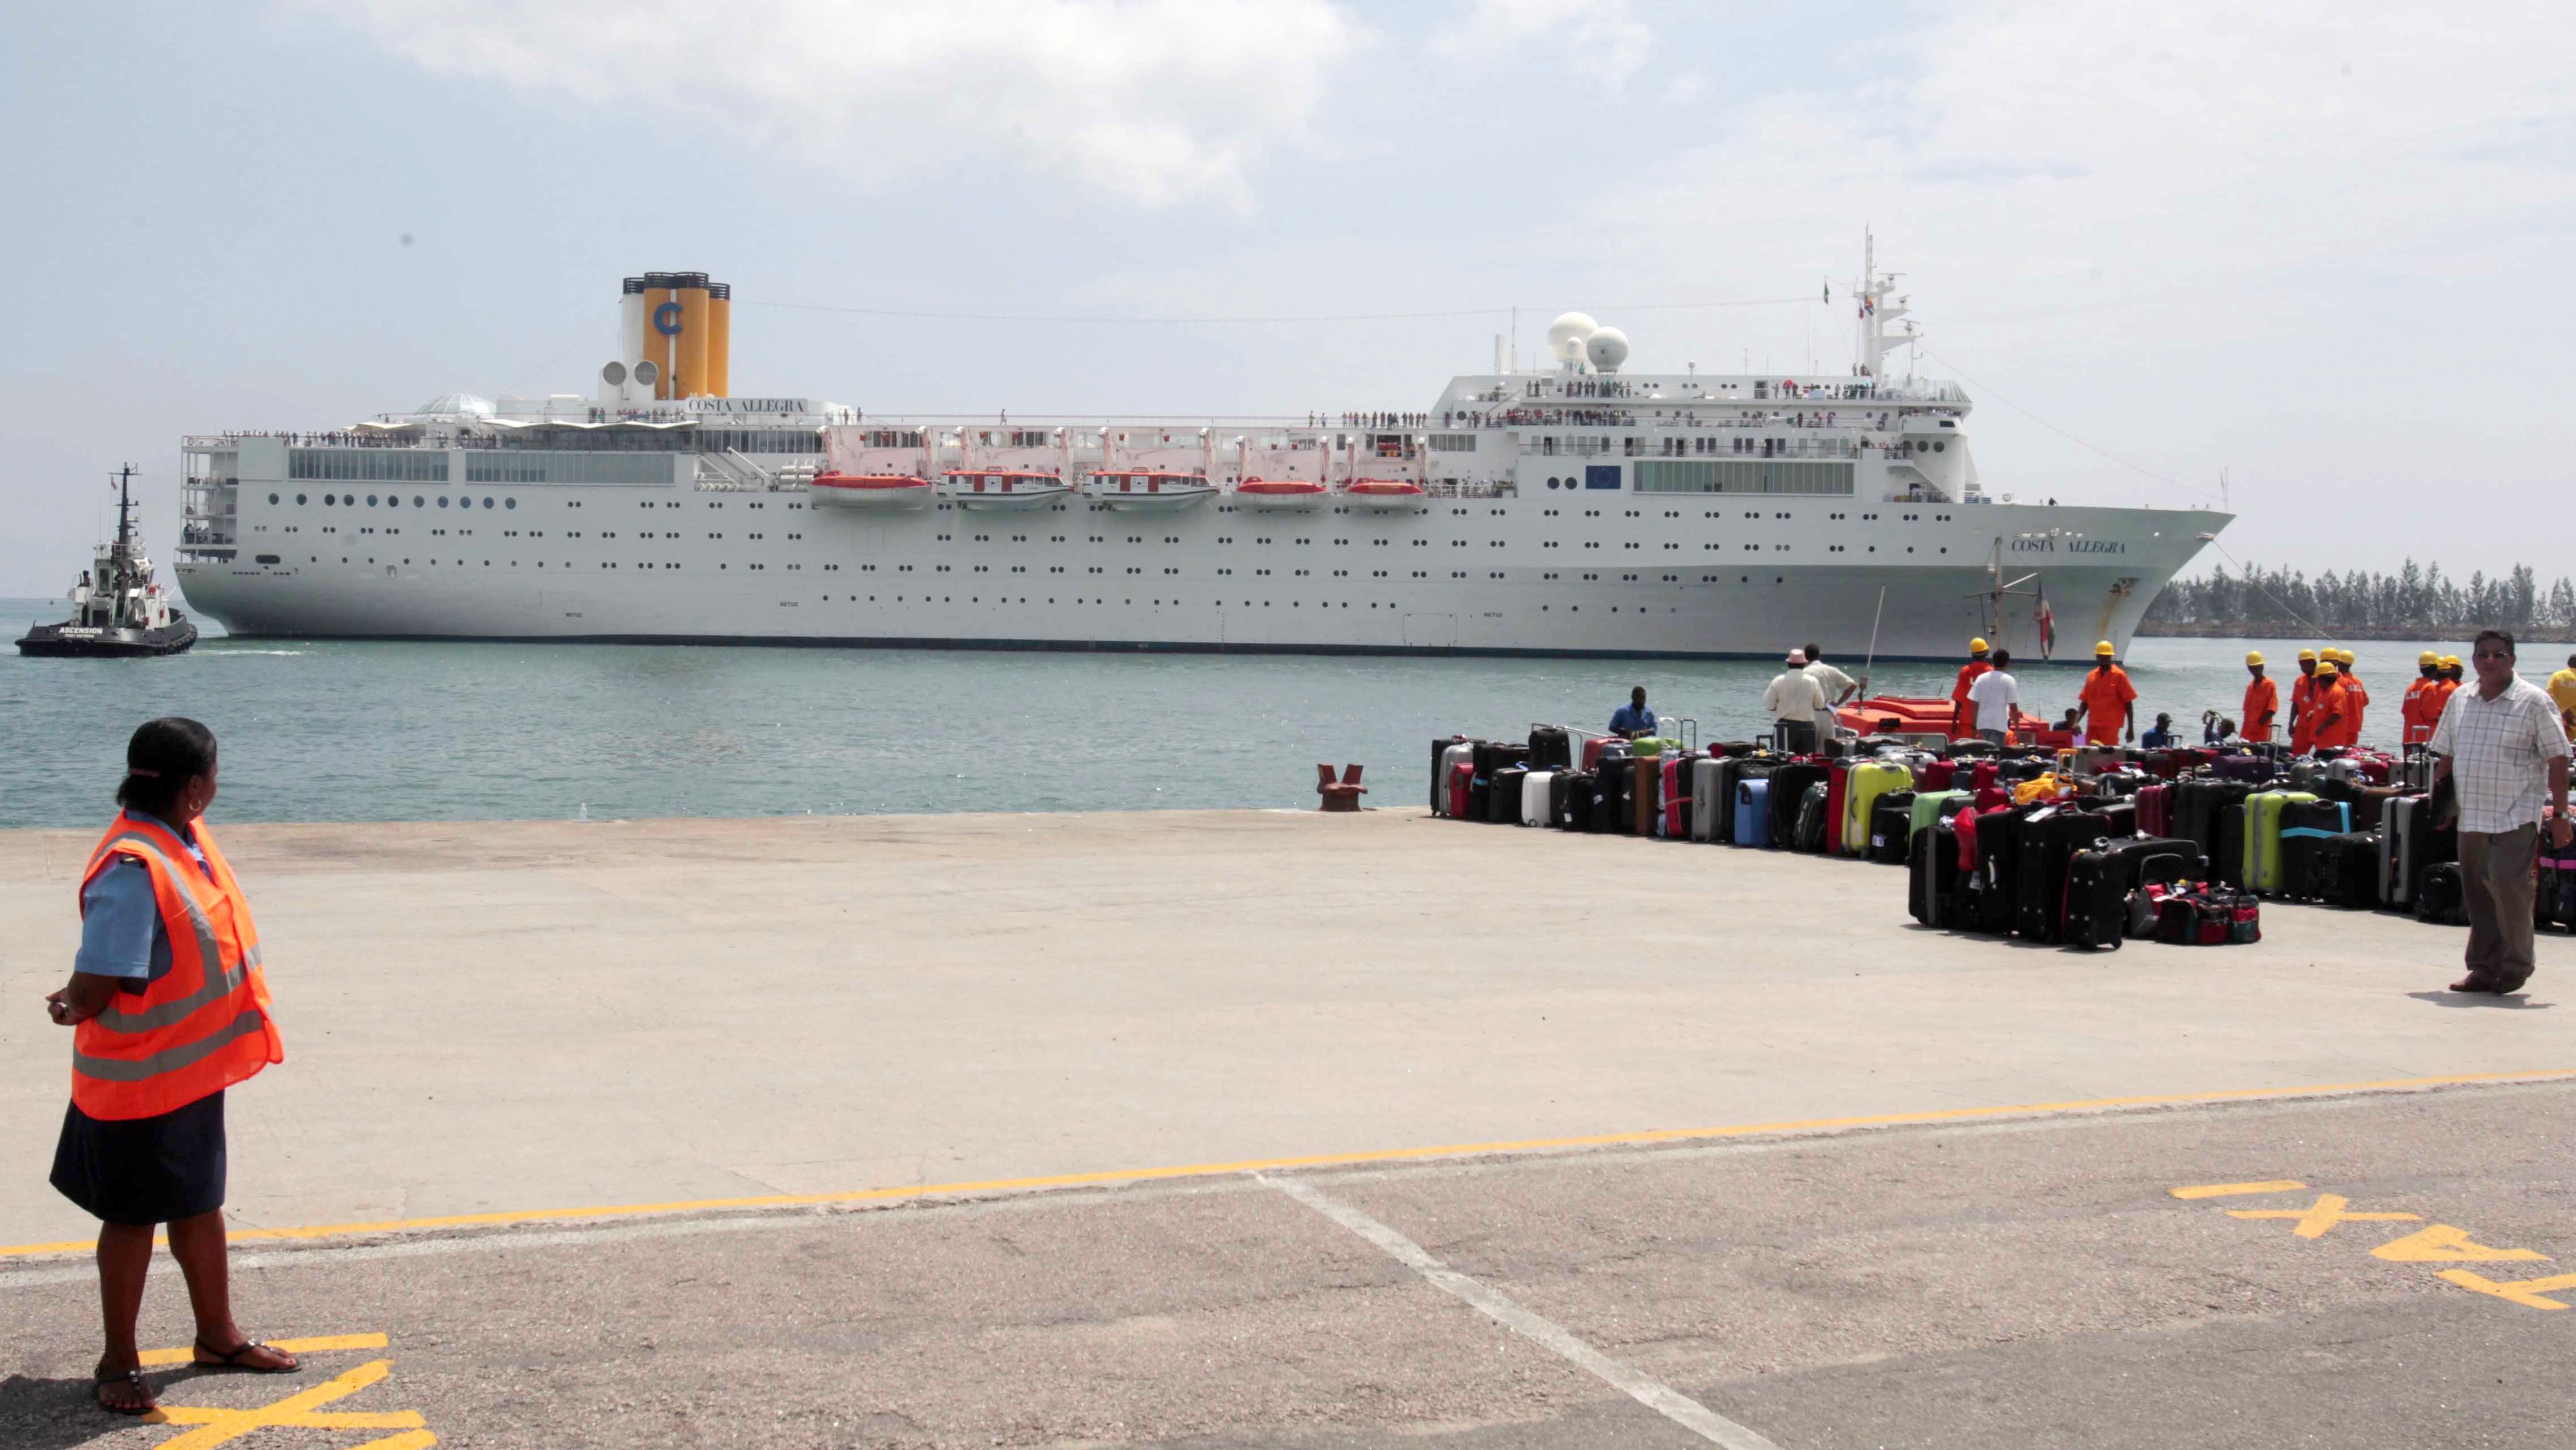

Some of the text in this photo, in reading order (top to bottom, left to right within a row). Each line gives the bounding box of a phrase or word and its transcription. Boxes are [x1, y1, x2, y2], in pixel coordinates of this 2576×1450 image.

[654, 302, 683, 335] C
[689, 398, 804, 413] COSTA ALLEGRA
[2011, 539, 2125, 554] COSTA ALLEGRA
